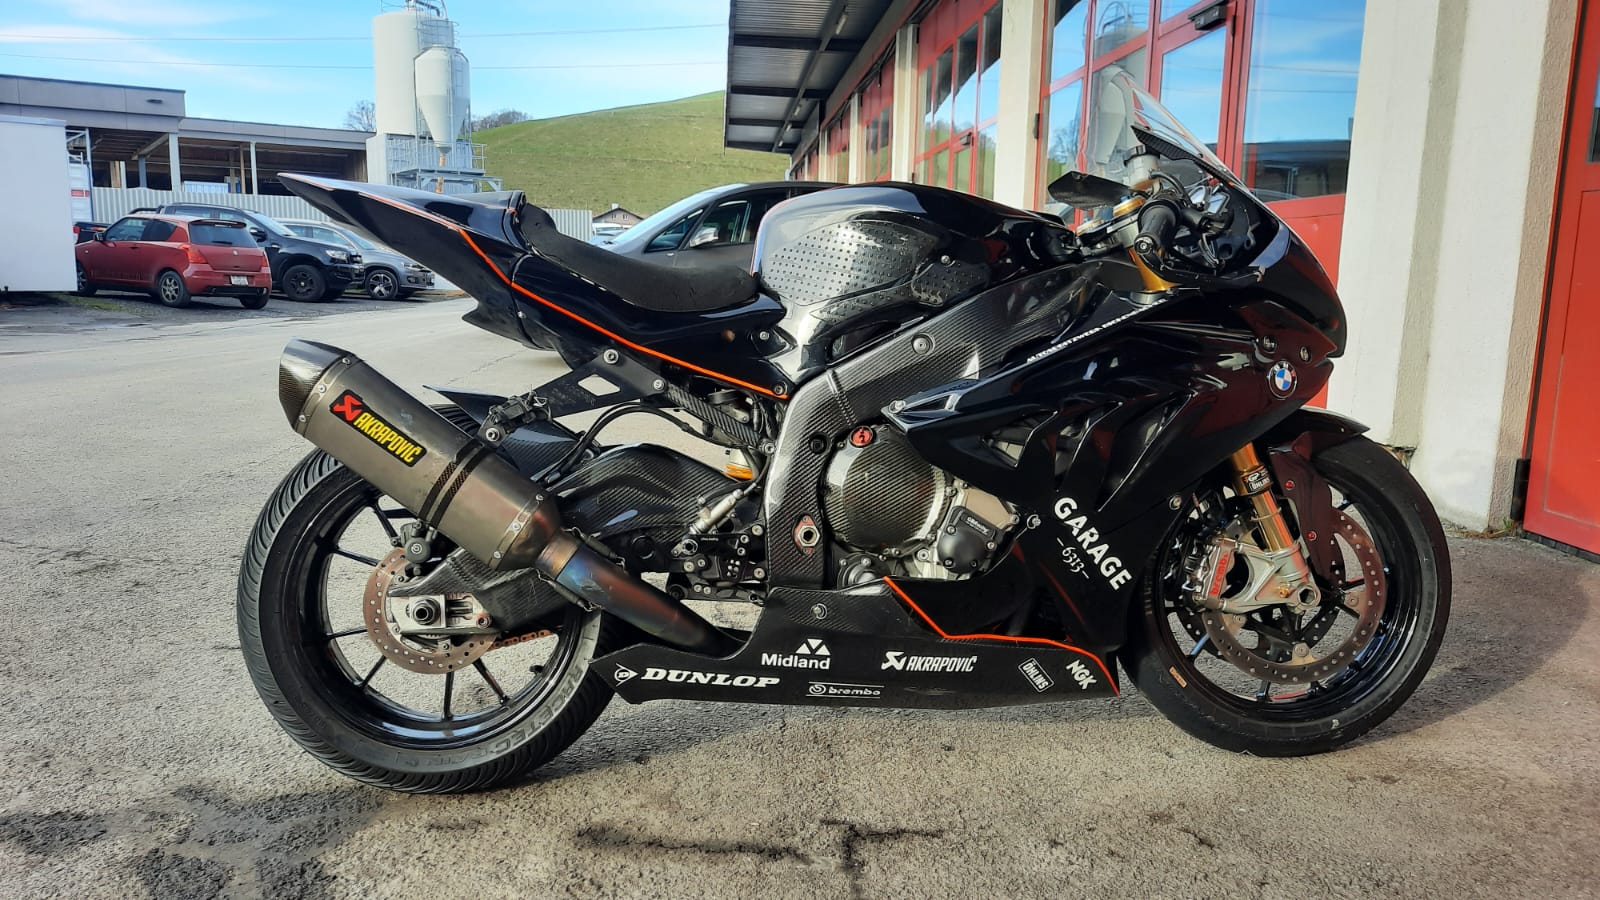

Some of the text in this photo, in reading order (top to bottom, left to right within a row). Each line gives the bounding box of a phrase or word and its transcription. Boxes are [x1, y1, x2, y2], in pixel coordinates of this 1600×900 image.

[1054, 497, 1132, 590] GARAGE
[1062, 546, 1085, 573] 6313
[761, 652, 831, 670] Midland
[1065, 659, 1097, 690] NGK
[640, 667, 781, 688] DUNLOP
[1022, 660, 1049, 690] ÖHLINS
[828, 686, 881, 696] brembo
